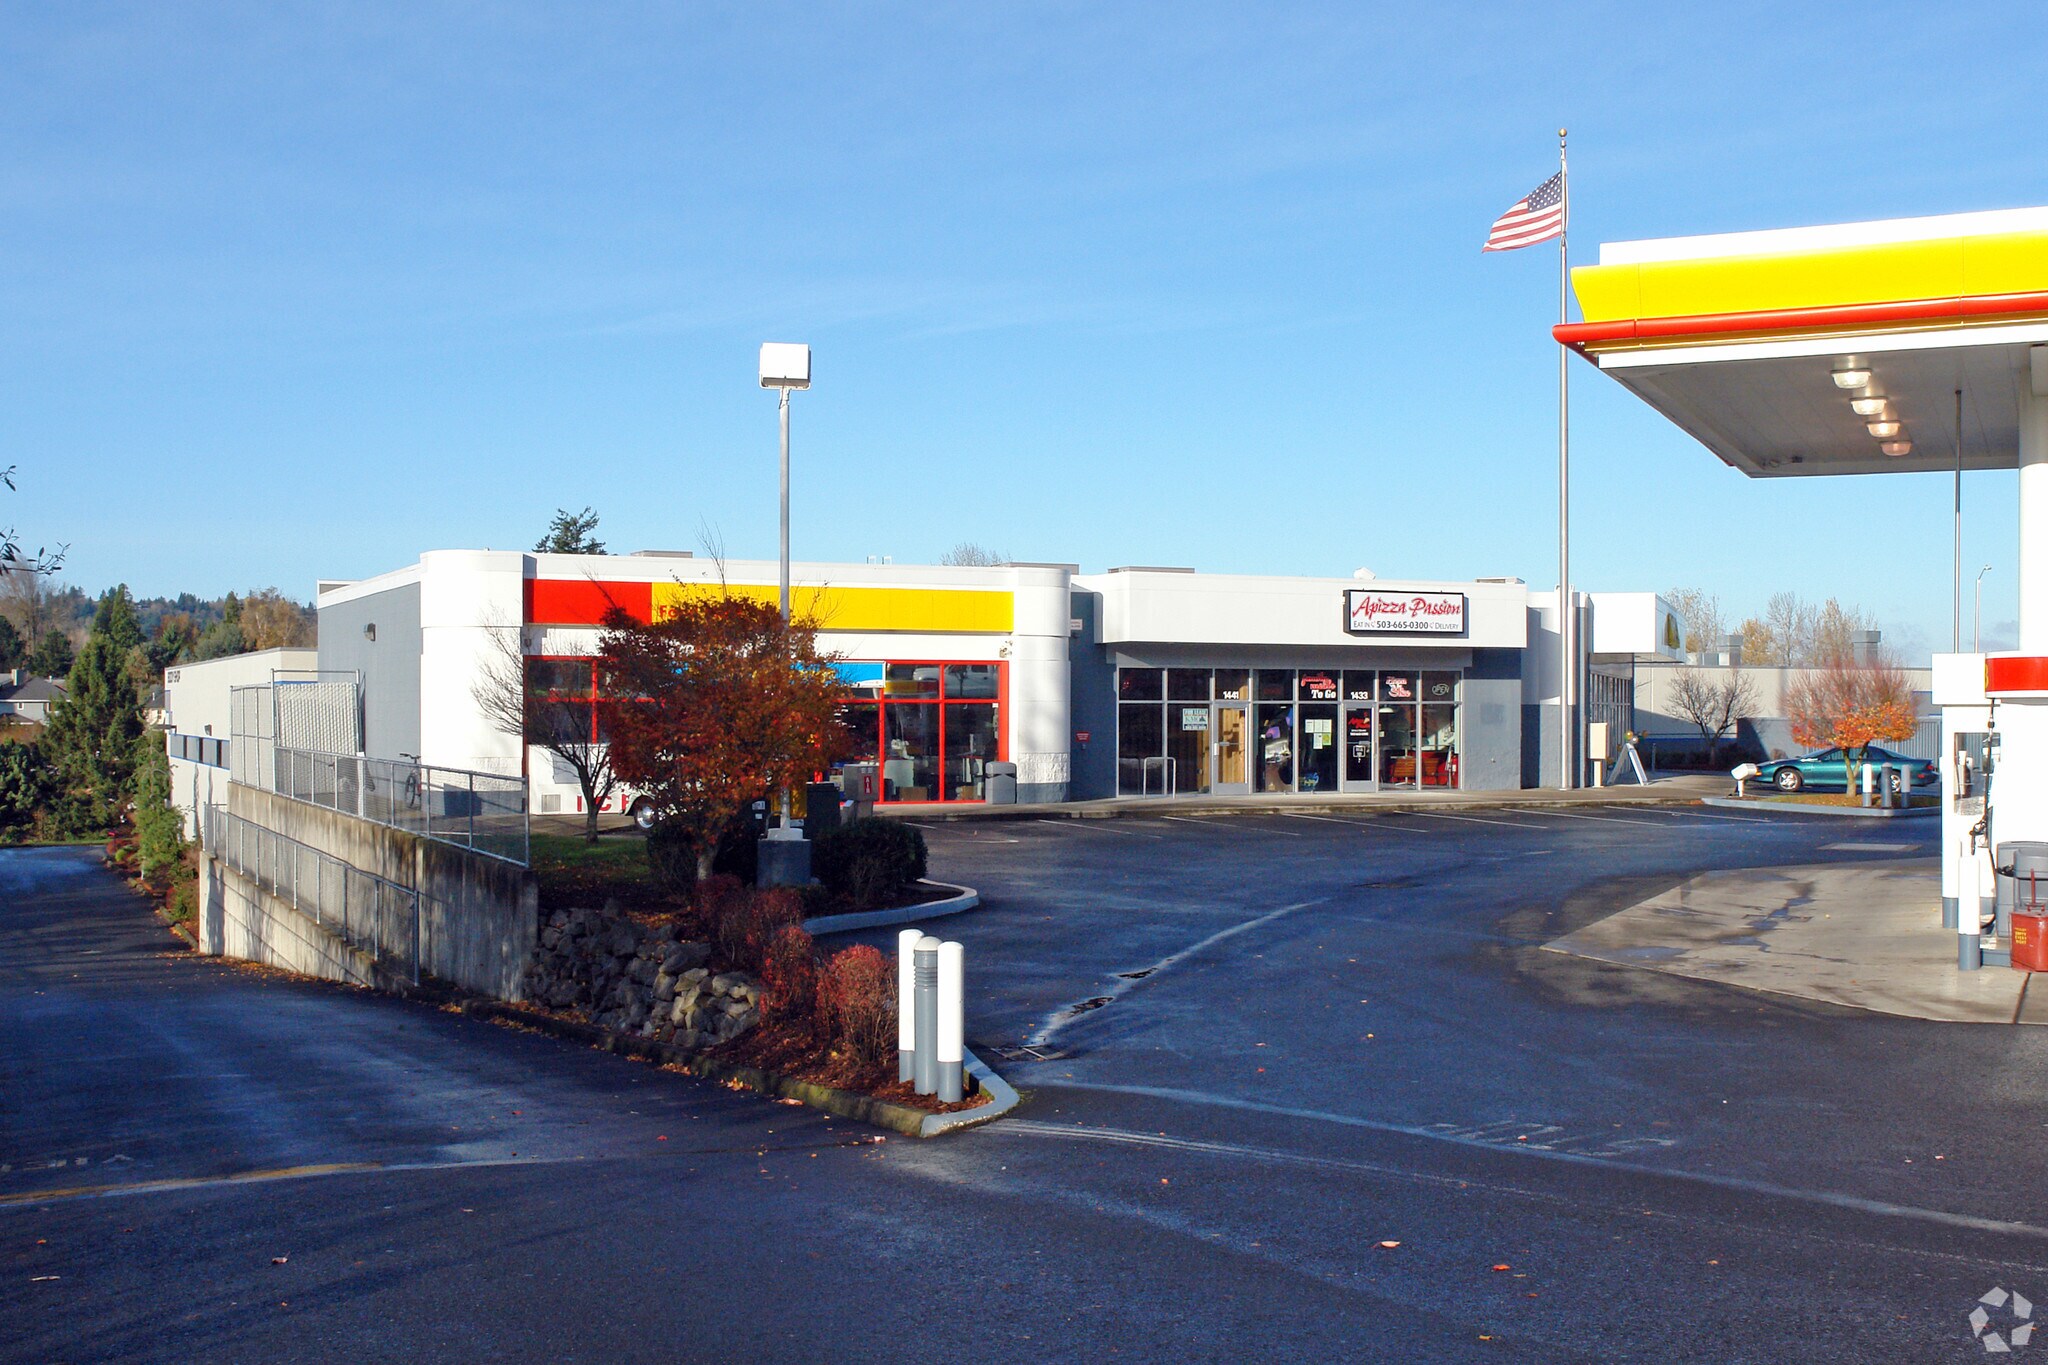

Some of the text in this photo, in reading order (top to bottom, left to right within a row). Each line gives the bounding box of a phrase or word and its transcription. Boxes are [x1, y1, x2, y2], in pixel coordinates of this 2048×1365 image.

[1352, 595, 1461, 620] Apizza Passion
[1376, 620, 1429, 630] 503-665-0300
[1223, 690, 1239, 699] 1441
[1311, 689, 1337, 699] To Go
[1350, 691, 1368, 700] 1433
